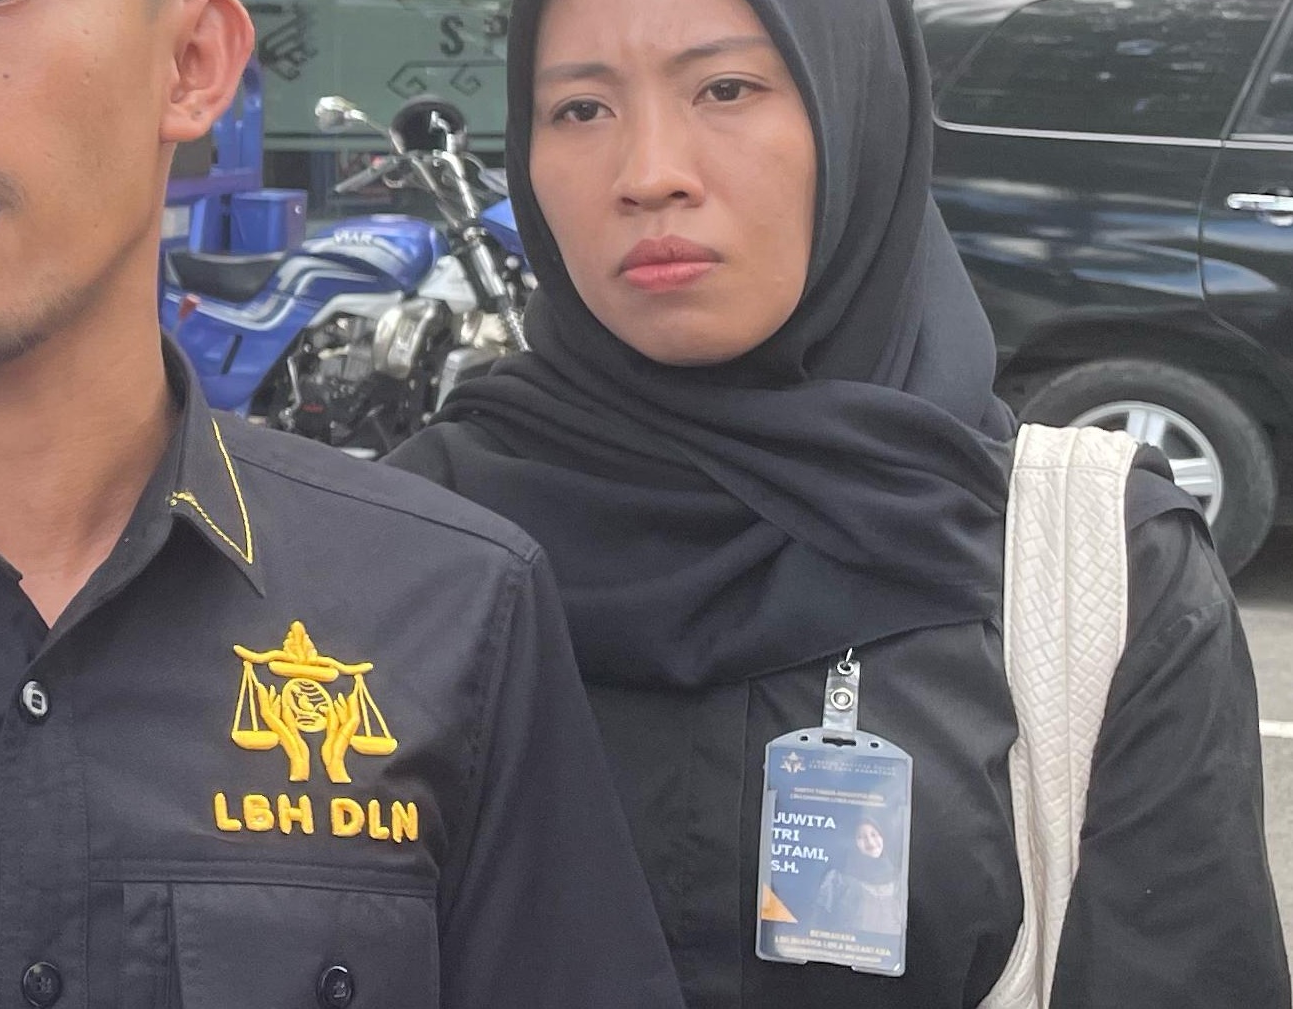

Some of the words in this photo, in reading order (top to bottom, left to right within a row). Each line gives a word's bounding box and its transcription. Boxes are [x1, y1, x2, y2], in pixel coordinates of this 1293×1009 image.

[214, 792, 314, 835] LBH
[330, 799, 419, 843] DLN
[773, 811, 836, 829] JUWITA
[772, 827, 800, 841] TRI
[771, 843, 829, 863] UTAMI,
[771, 859, 800, 874] S.H.
